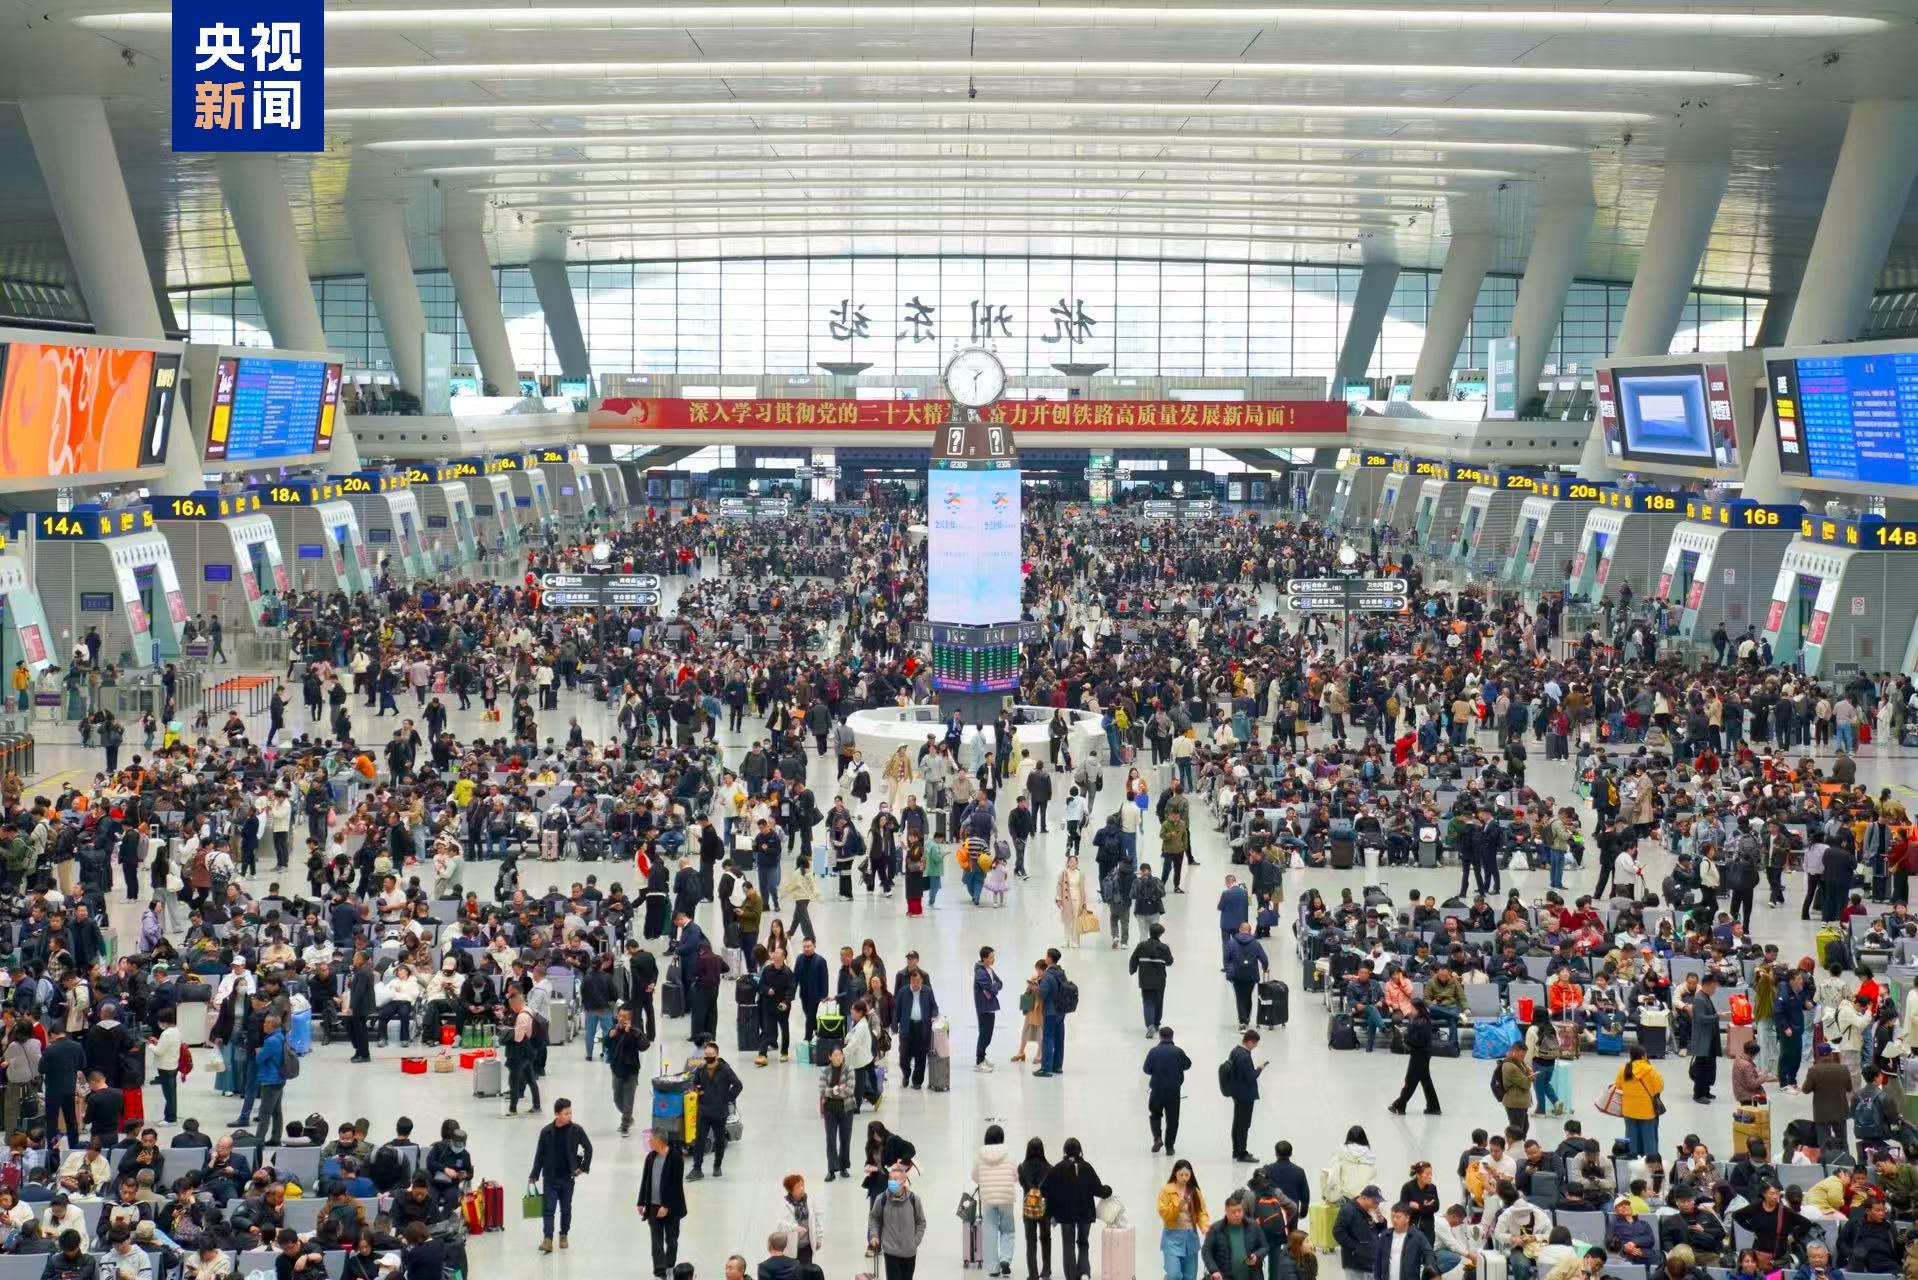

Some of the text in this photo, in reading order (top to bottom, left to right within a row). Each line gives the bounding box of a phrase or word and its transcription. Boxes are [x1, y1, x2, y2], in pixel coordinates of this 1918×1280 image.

[543, 452, 563, 461] 28A
[1367, 456, 1386, 465] 28B
[343, 478, 371, 492] 20A
[1507, 476, 1532, 487] 22B
[270, 487, 300, 502] 18A
[1569, 484, 1597, 498] 20B
[172, 500, 207, 516] 16A
[1644, 494, 1675, 510] 18B
[1743, 508, 1779, 525] 16B
[43, 516, 84, 536] 14A
[1875, 527, 1918, 545] 14B
